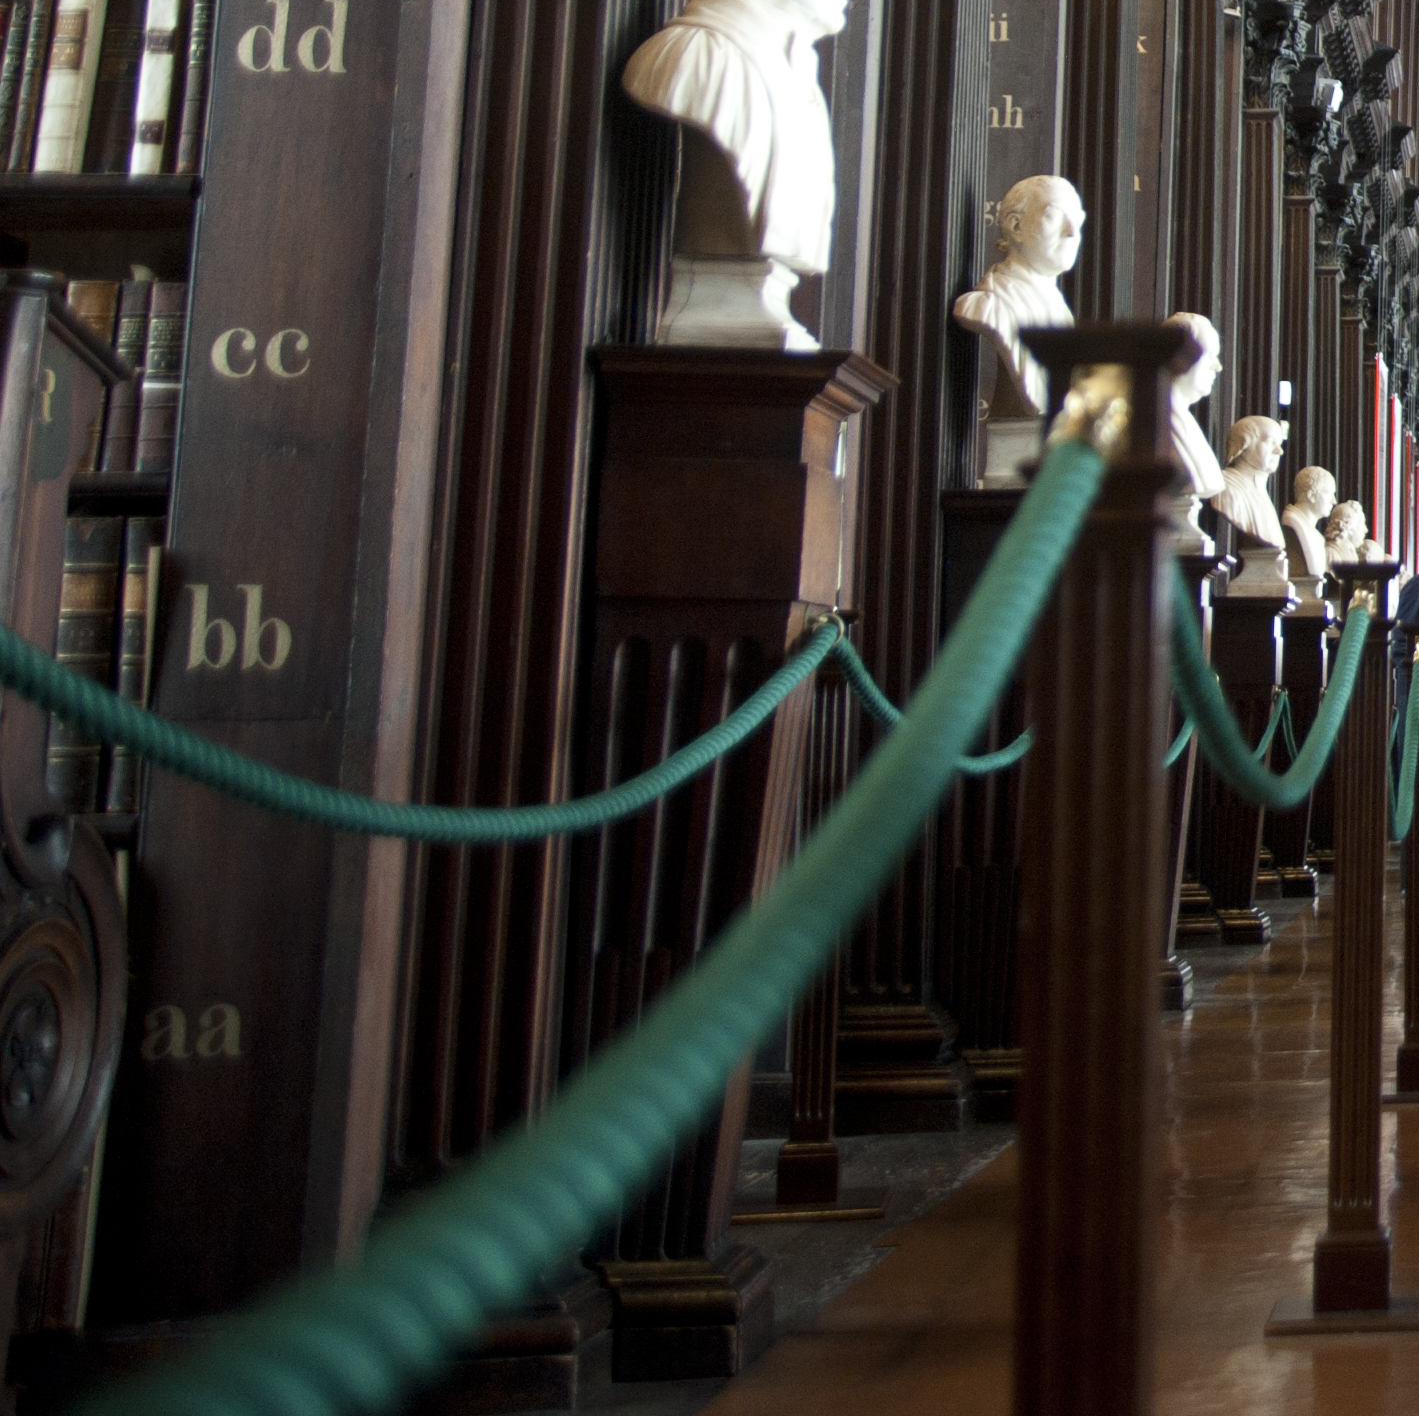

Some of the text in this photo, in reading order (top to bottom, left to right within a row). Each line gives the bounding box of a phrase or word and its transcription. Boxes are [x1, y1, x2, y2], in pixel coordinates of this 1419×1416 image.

[211, 328, 309, 378] cc
[187, 584, 291, 670] bb
[141, 1001, 245, 1061] aa
